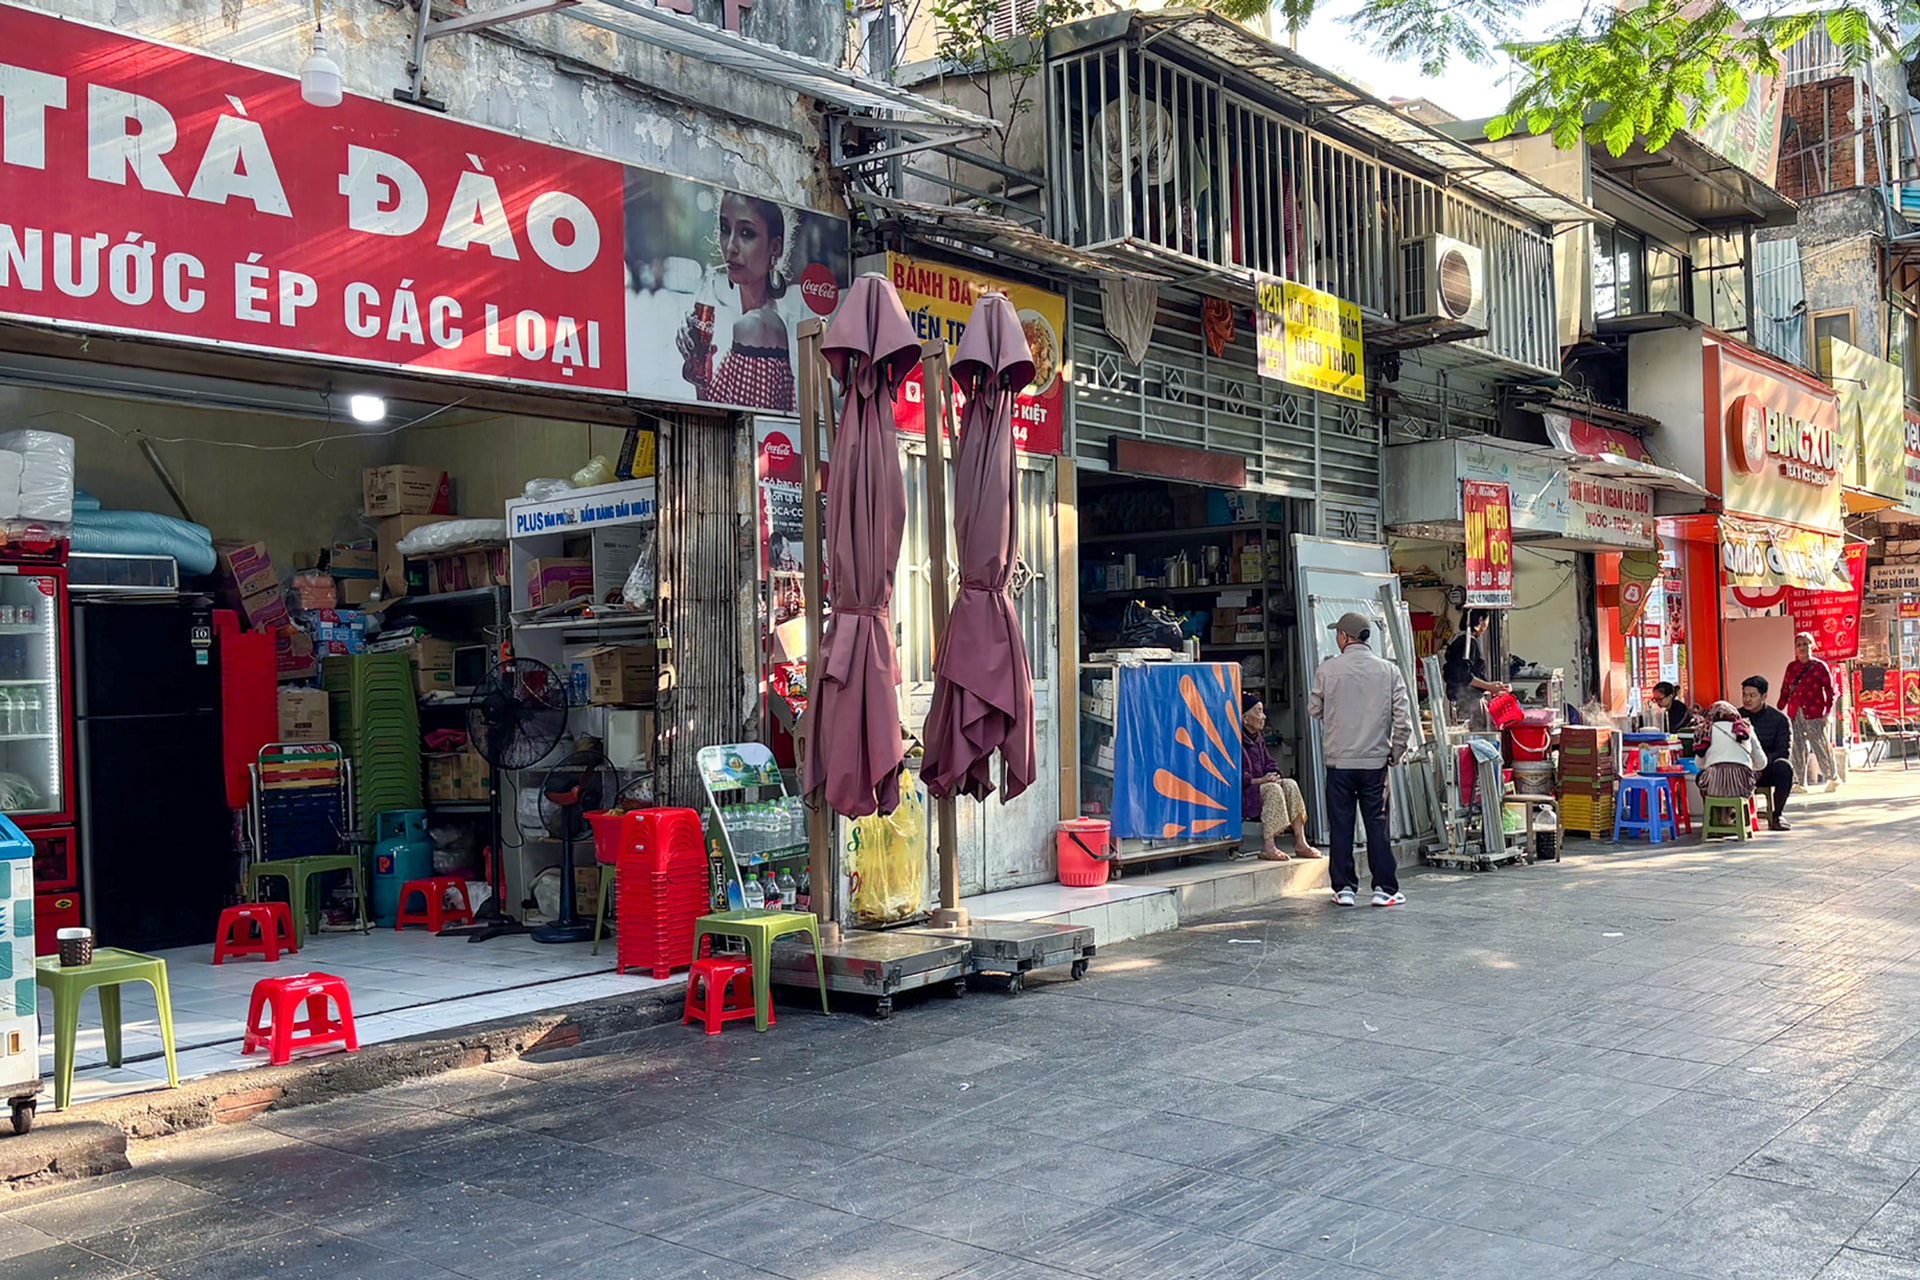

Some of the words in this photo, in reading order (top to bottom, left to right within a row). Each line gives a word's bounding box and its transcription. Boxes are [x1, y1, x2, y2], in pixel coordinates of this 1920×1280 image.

[0, 62, 293, 218] TRÀ
[338, 144, 600, 273] ĐÀO
[0, 222, 206, 313] NƯỚC
[235, 252, 318, 327] ÉP
[344, 278, 463, 349] CÁC
[485, 303, 600, 376] LOẠI
[893, 261, 944, 299] BÁNH
[948, 277, 973, 307] ĐA
[1258, 281, 1282, 316] 42H
[905, 304, 941, 340] IẾN
[1308, 303, 1335, 334] PHÒNG
[1021, 403, 1047, 426] KIỆT
[517, 511, 543, 533] PLUS
[764, 504, 803, 517] COCA-CO
[1489, 529, 1509, 566] ỐC
[195, 630, 207, 639] 10
